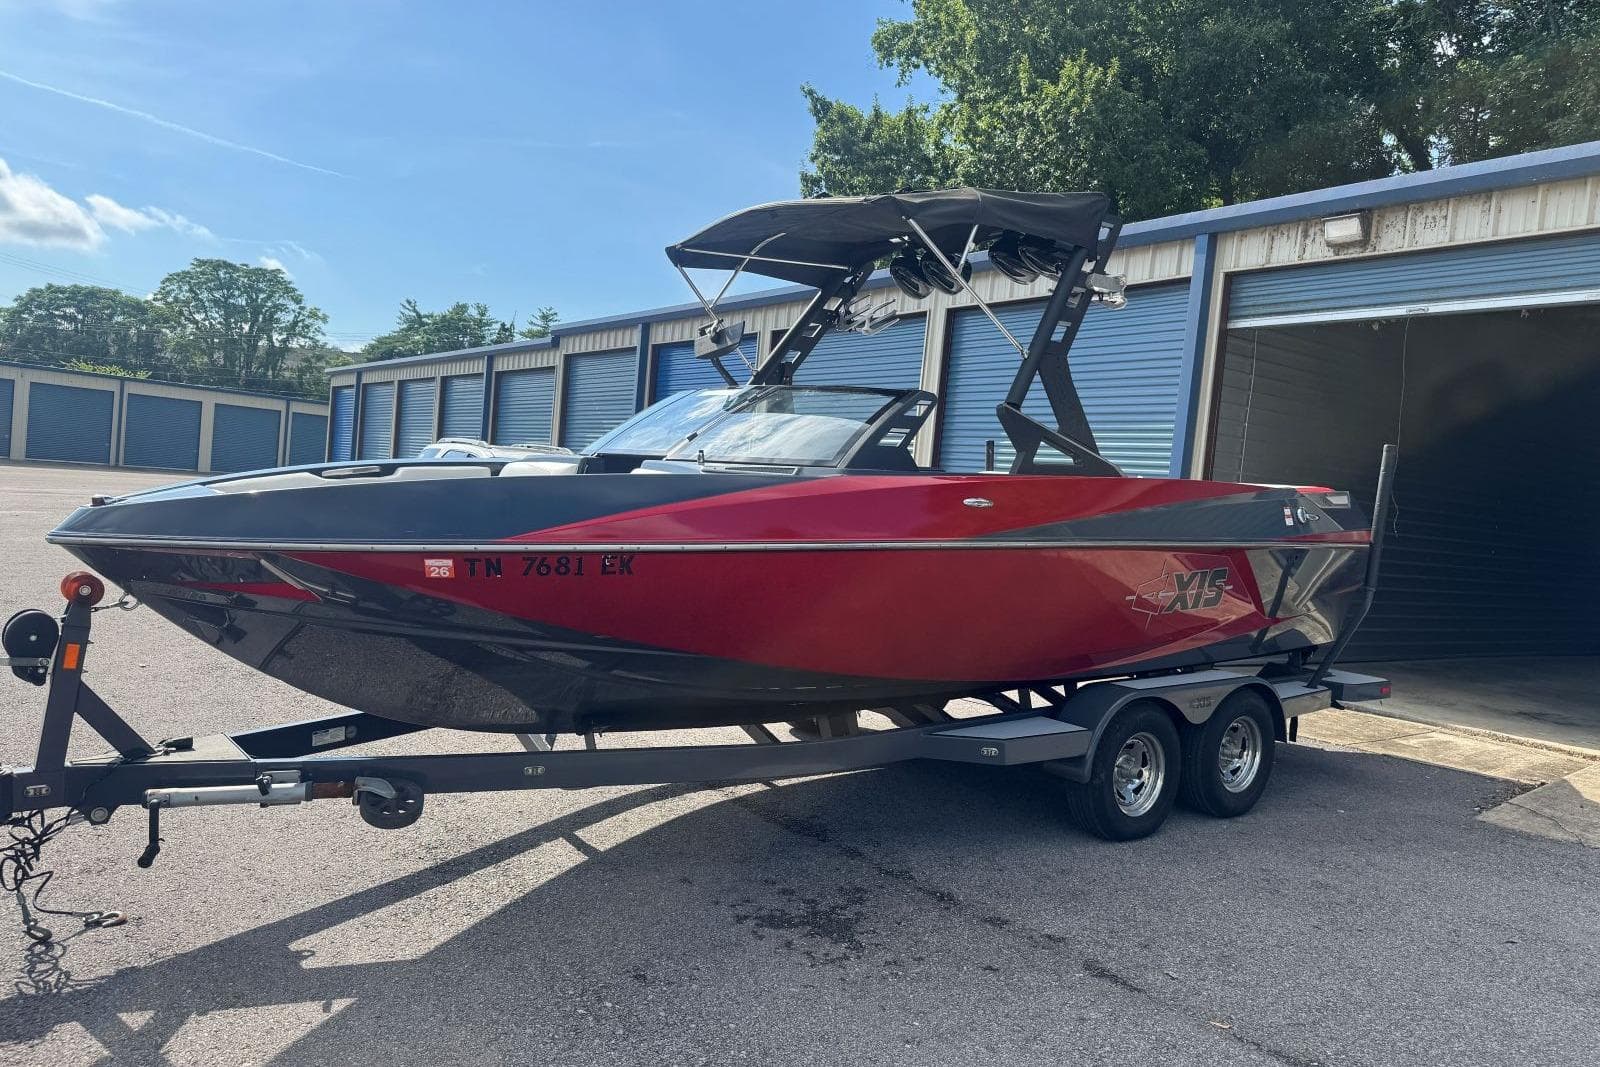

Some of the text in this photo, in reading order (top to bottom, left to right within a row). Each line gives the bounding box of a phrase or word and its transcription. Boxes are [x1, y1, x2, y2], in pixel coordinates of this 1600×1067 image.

[430, 566, 450, 577] 26
[464, 554, 634, 578] TN 7681 EK
